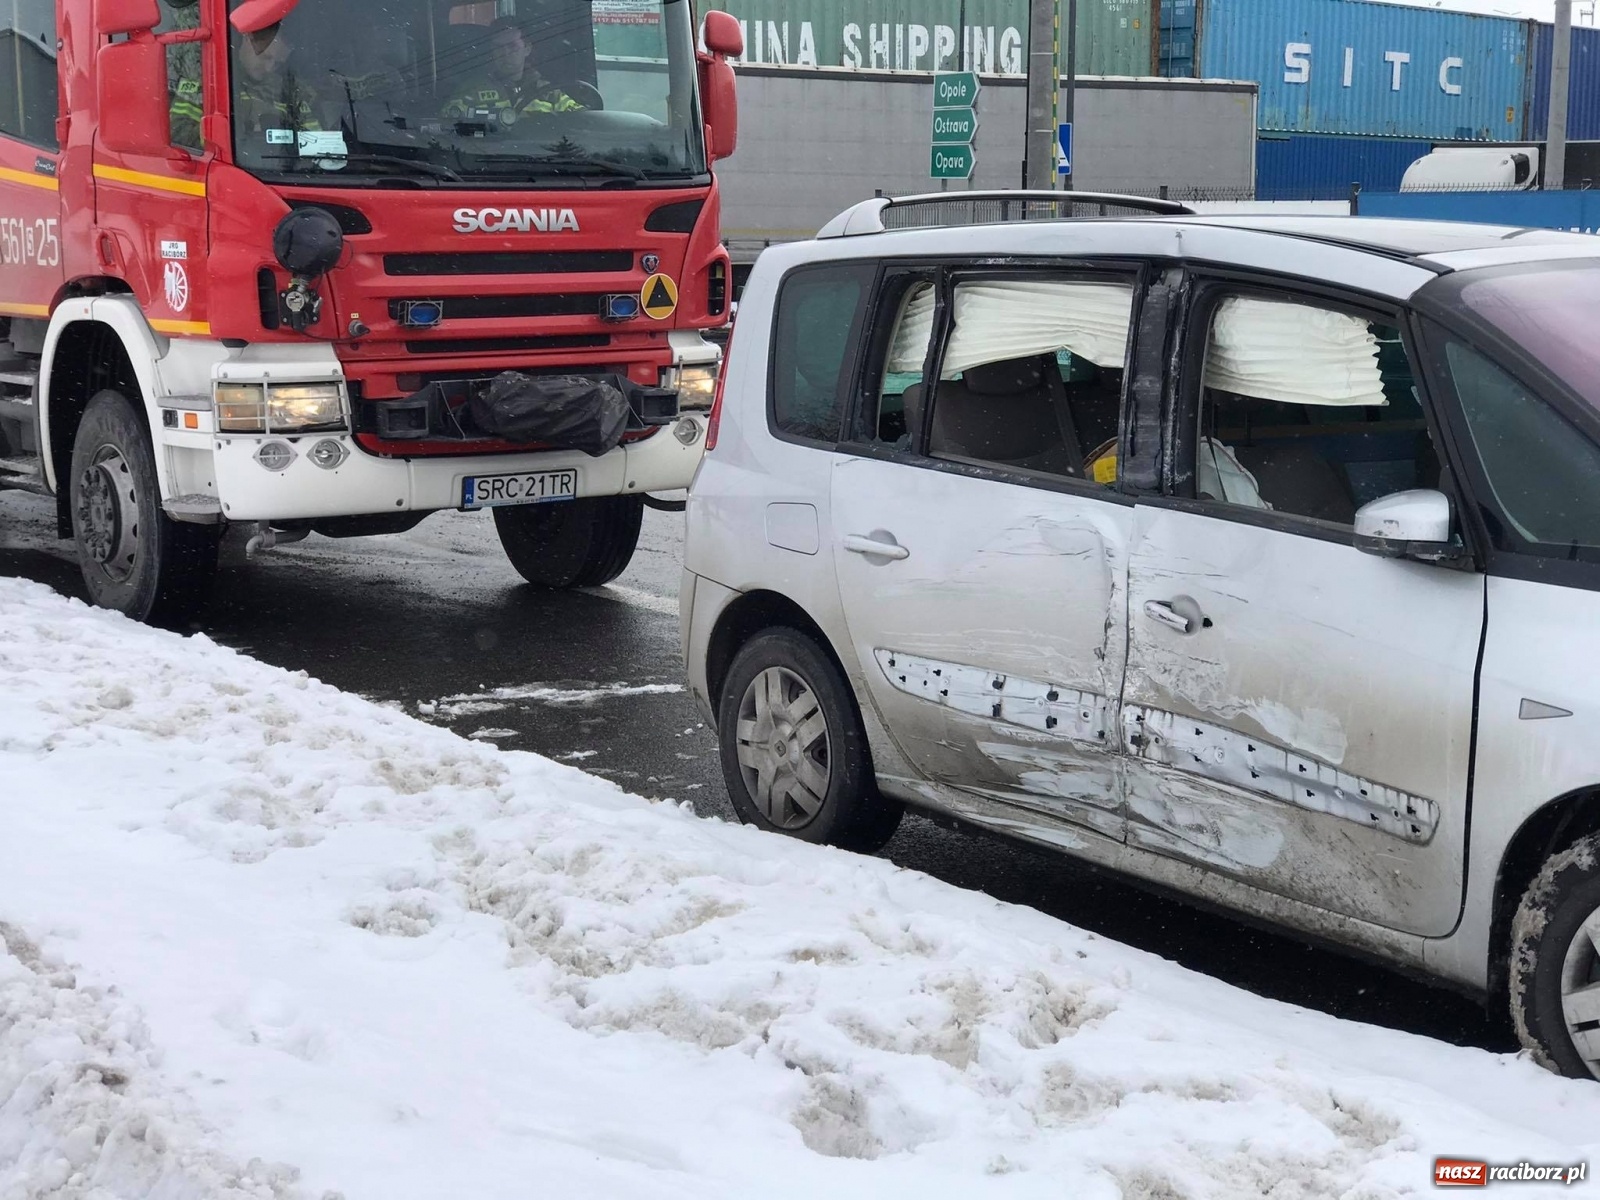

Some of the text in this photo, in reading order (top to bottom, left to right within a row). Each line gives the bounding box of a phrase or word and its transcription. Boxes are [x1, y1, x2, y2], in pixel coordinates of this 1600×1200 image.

[843, 22, 1022, 74] SHIPPING
[940, 81, 967, 102] Opole
[934, 117, 969, 133] Ostrava
[935, 152, 964, 173] Opava
[452, 208, 580, 233] SCANIA
[477, 473, 572, 500] SRC 21TR
